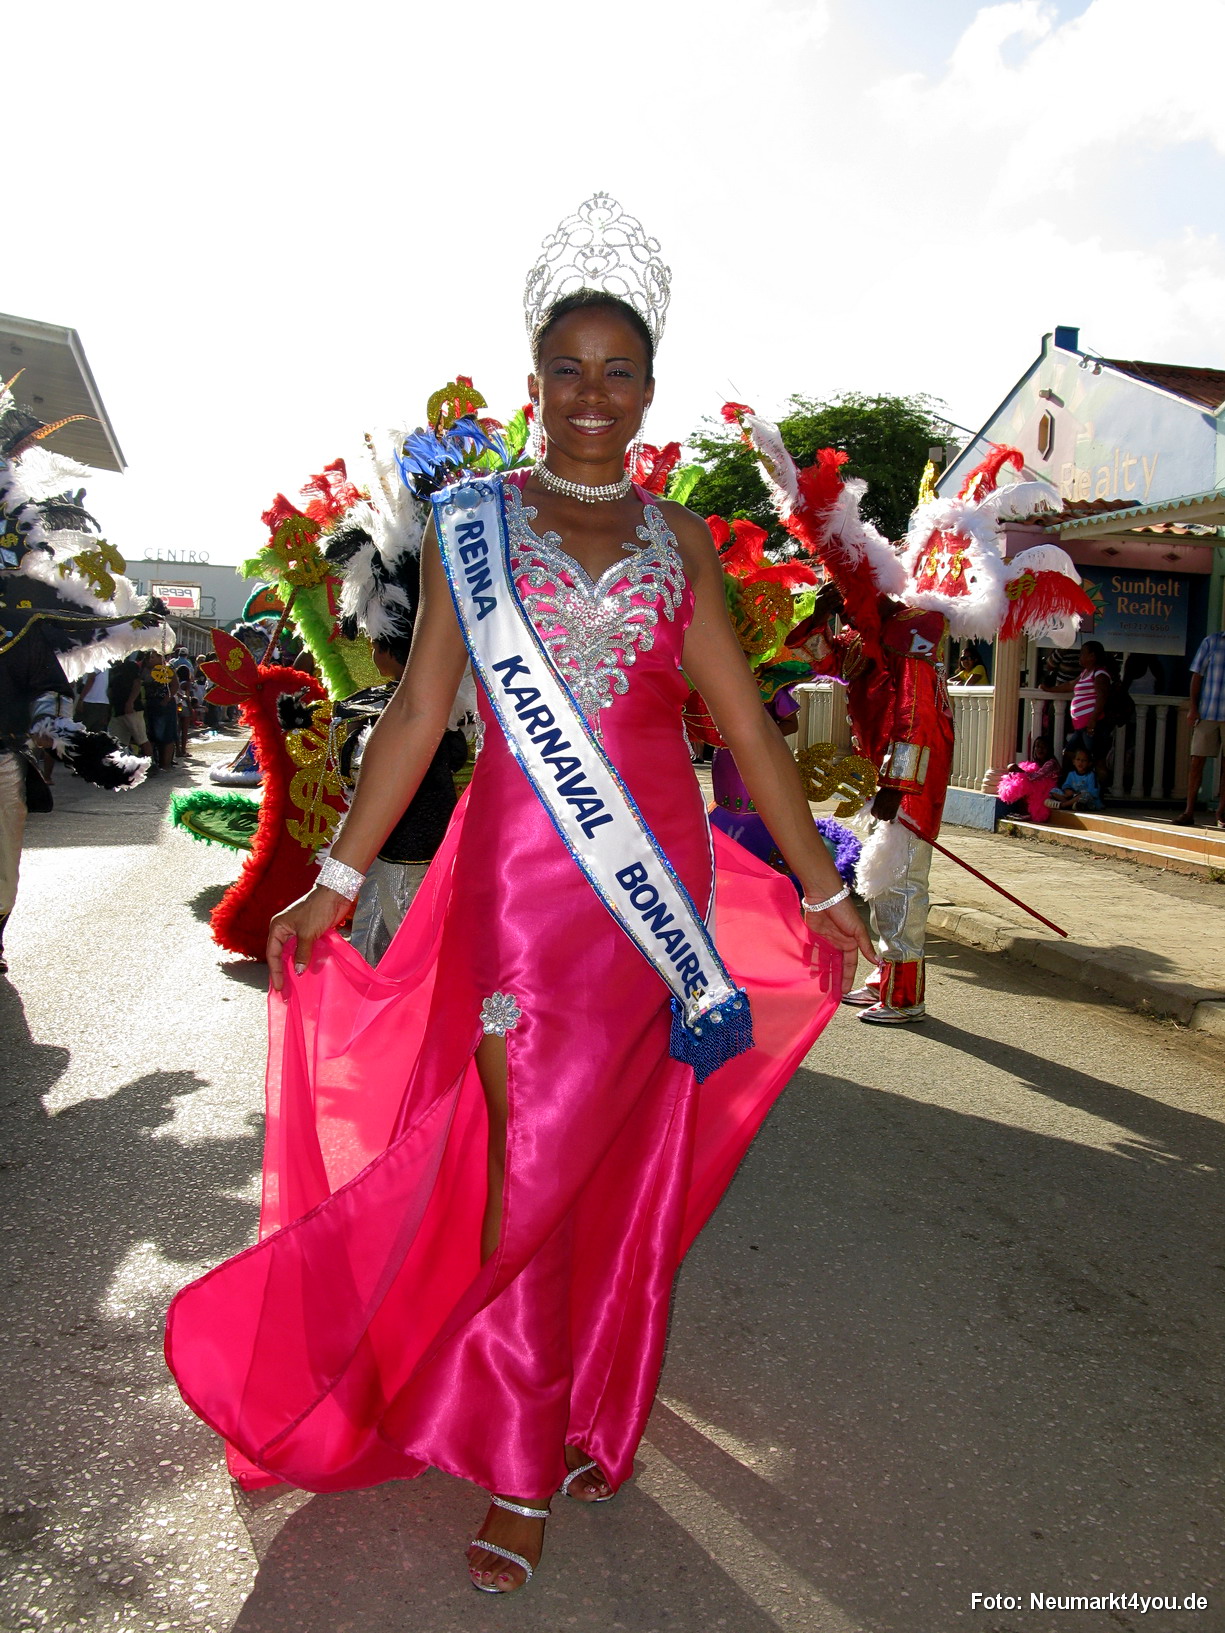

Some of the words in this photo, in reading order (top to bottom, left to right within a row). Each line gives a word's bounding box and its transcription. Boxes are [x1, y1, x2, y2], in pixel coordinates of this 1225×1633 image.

[1060, 448, 1159, 502] Realty
[144, 548, 209, 562] CENTRO
[1111, 575, 1182, 597] Sunbelt
[1117, 596, 1173, 622] Realty
[455, 519, 497, 622] REINA
[491, 654, 615, 840] KARNAVAL
[615, 860, 710, 1002] BONAIRE
